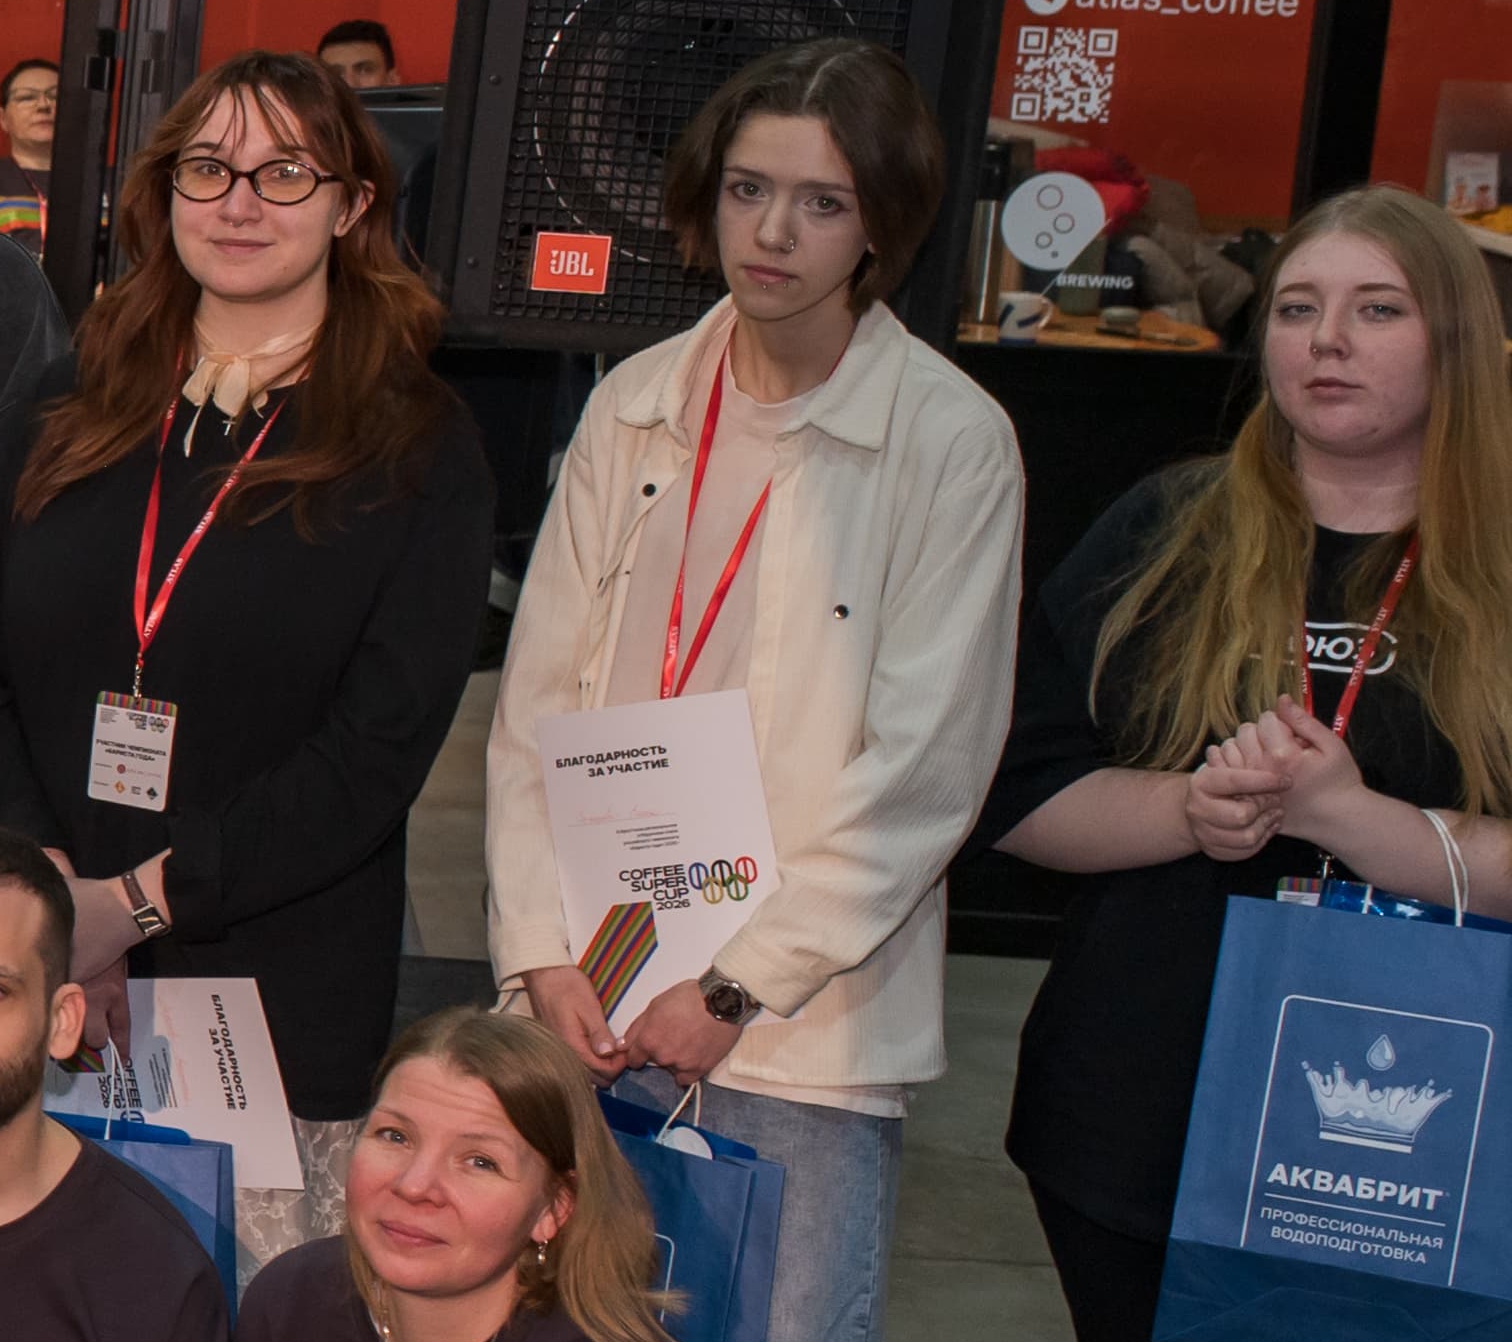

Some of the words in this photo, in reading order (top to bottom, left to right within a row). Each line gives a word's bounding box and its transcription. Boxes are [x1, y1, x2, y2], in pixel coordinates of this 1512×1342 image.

[550, 249, 594, 277] JBL
[1056, 272, 1134, 290] BREWING
[166, 557, 184, 585] ATLAS
[555, 744, 668, 769] БЛАГОДАРНОСТЬ
[587, 767, 605, 778] ЗА
[606, 757, 670, 776] УЧАСТИЕ
[618, 863, 685, 882] COFFEE
[630, 875, 688, 893] SUPER
[652, 886, 690, 902] CUP
[655, 898, 691, 911] 2026
[208, 1027, 217, 1046] ЗА
[211, 993, 248, 1112] БЛАГОДАРНОСТЬ
[123, 1057, 143, 1109] OFFEE
[212, 1048, 238, 1111] УЧАСТИЕ
[1266, 1162, 1443, 1211] АКВАБРИТ
[1260, 1206, 1443, 1250] ПРОФЕССИОНАЛЬНАЯ
[1270, 1225, 1427, 1265] ВОДОПОДГОТОВКА
